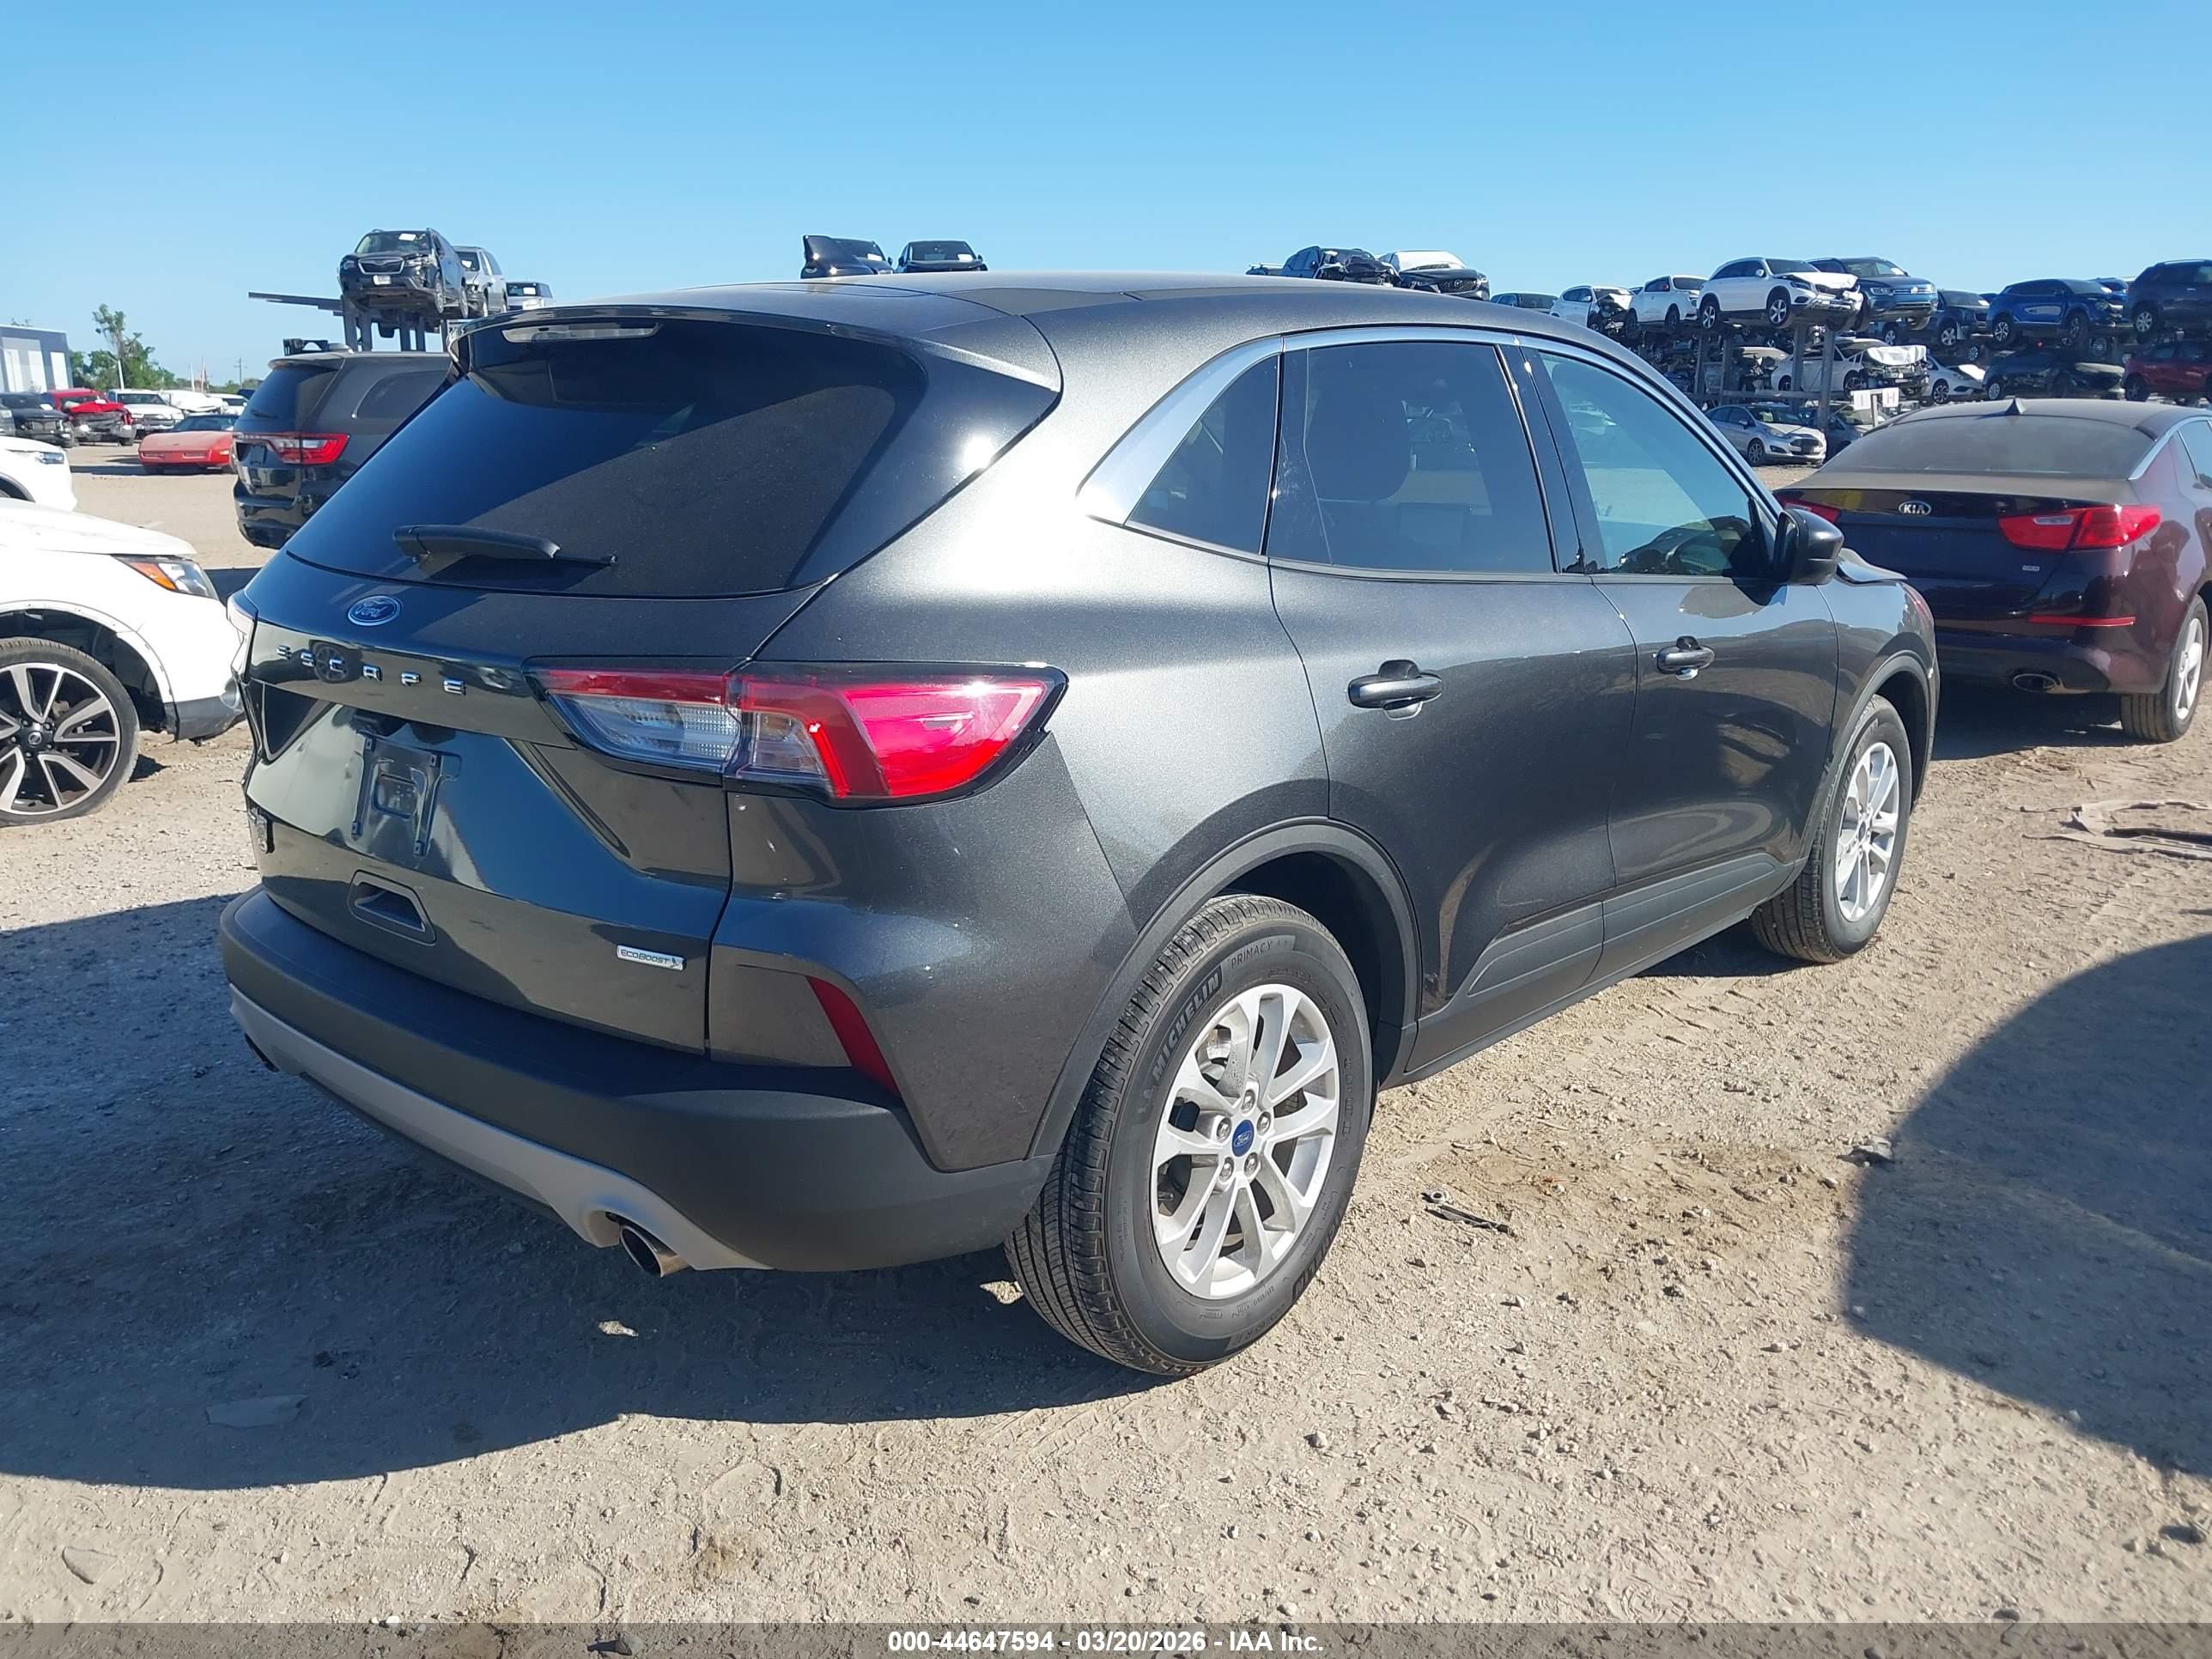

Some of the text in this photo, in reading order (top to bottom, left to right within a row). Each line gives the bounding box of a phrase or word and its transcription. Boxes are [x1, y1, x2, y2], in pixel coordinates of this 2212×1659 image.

[1904, 504, 1925, 514] KIA
[276, 645, 466, 696] ESCAPE
[1231, 940, 1273, 969] PRIMACY
[1152, 971, 1220, 1082] MICHELIN
[1236, 1132, 1251, 1146] Ford
